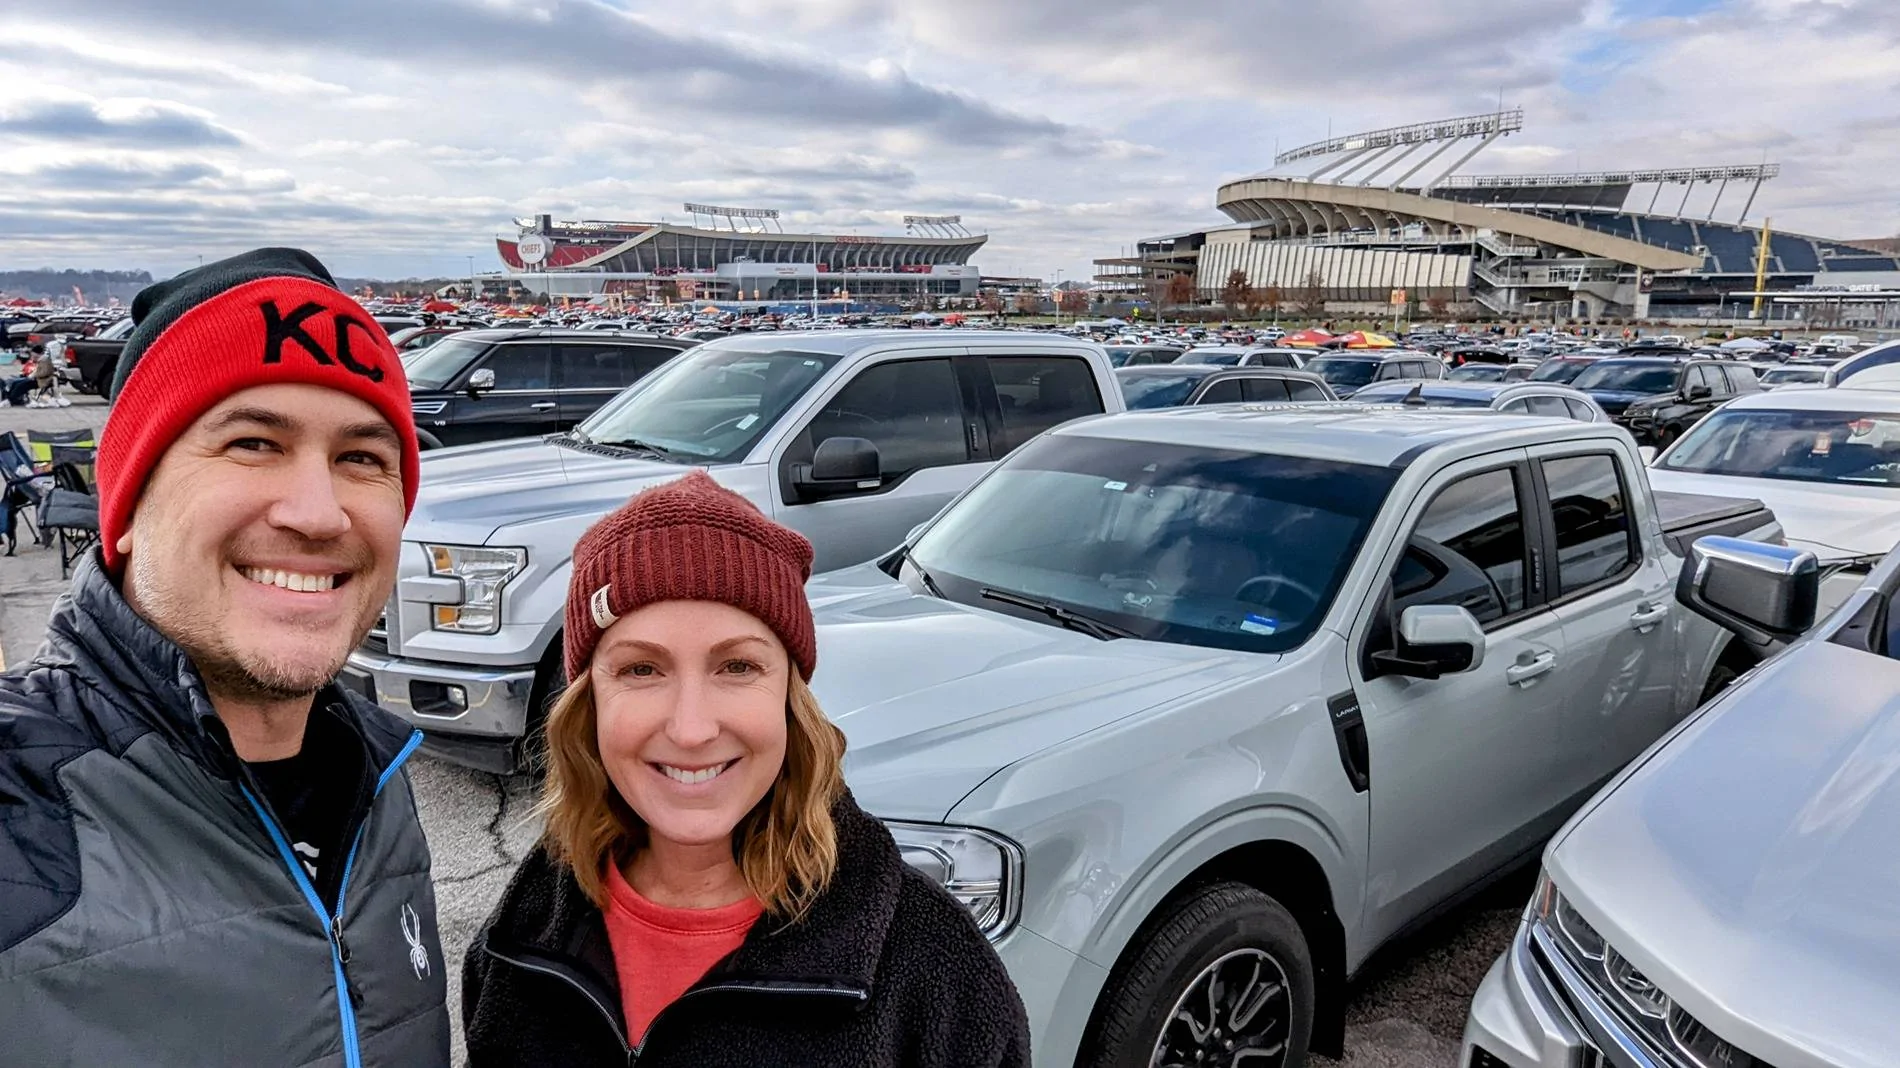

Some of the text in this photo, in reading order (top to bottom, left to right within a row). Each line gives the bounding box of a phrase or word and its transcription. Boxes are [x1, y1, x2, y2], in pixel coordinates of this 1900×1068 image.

[521, 244, 541, 254] CHIEFS
[1848, 284, 1872, 292] GATE
[260, 300, 385, 383] KC
[1335, 705, 1359, 718] LARIAT
